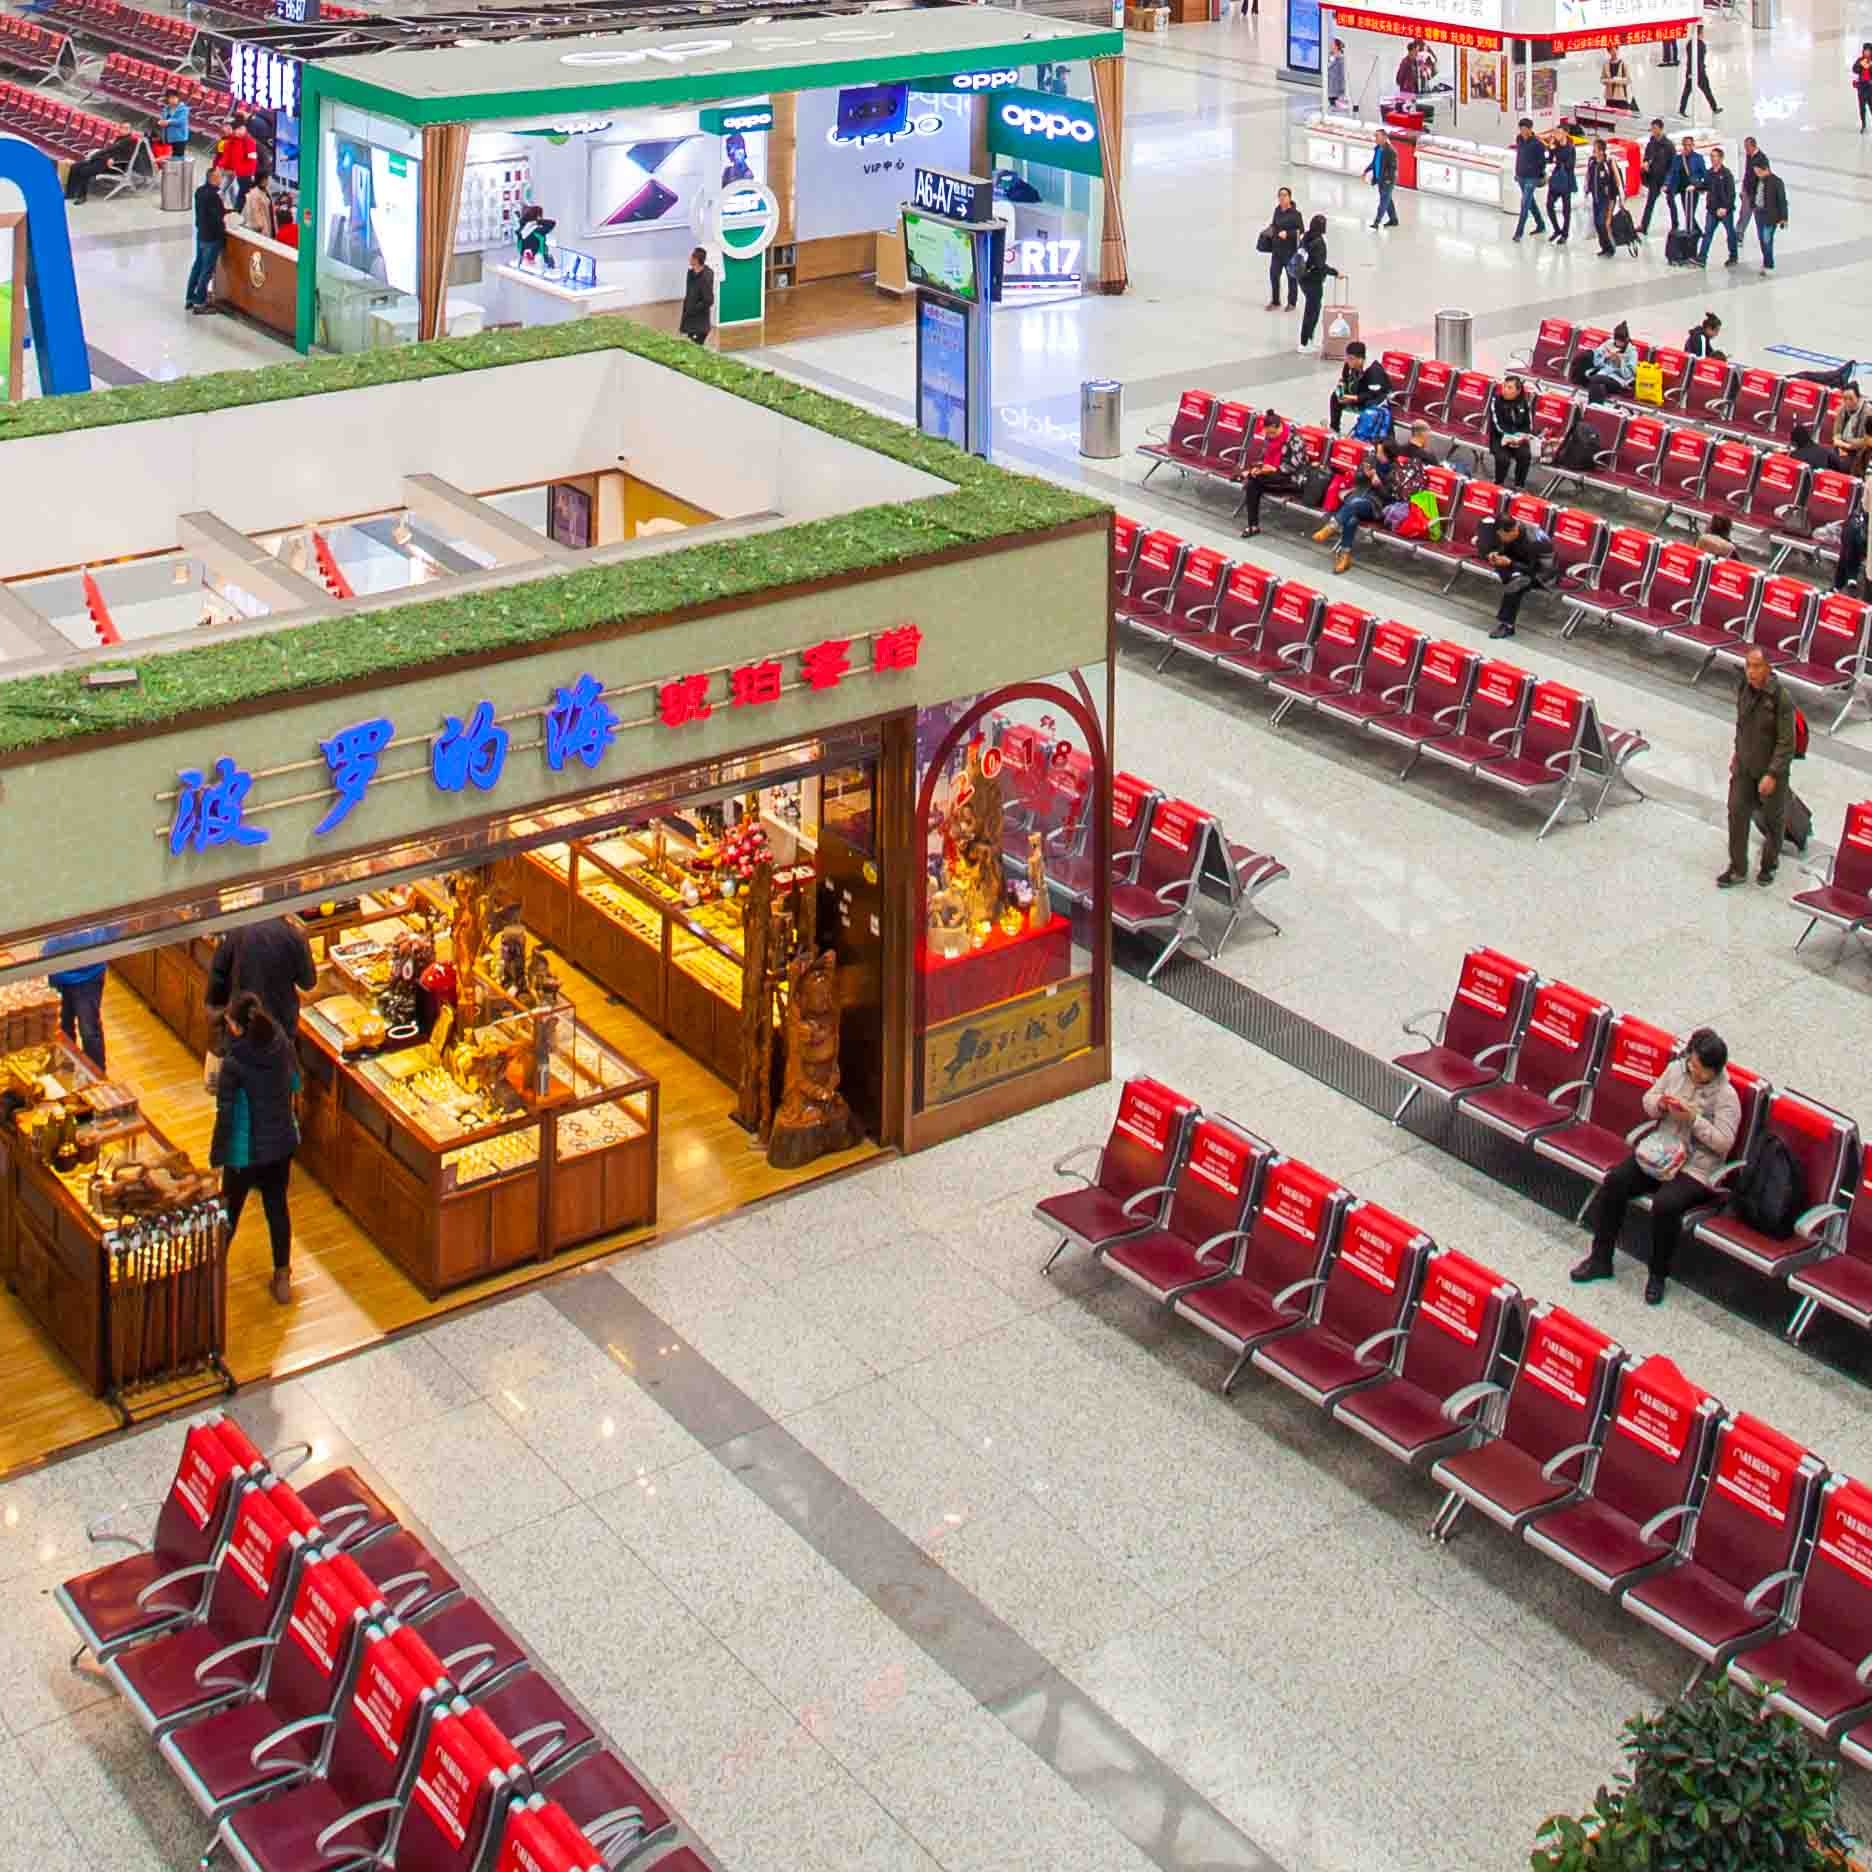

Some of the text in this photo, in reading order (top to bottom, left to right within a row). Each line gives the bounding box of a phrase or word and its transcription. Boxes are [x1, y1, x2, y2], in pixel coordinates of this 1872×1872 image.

[953, 70, 1019, 91] oppo
[723, 112, 772, 129] oppo
[1001, 103, 1095, 142] oppo
[915, 169, 952, 214] A6-A7
[1020, 240, 1081, 277] R17
[168, 674, 620, 857] 波罗的海
[950, 740, 1073, 808] 2018
